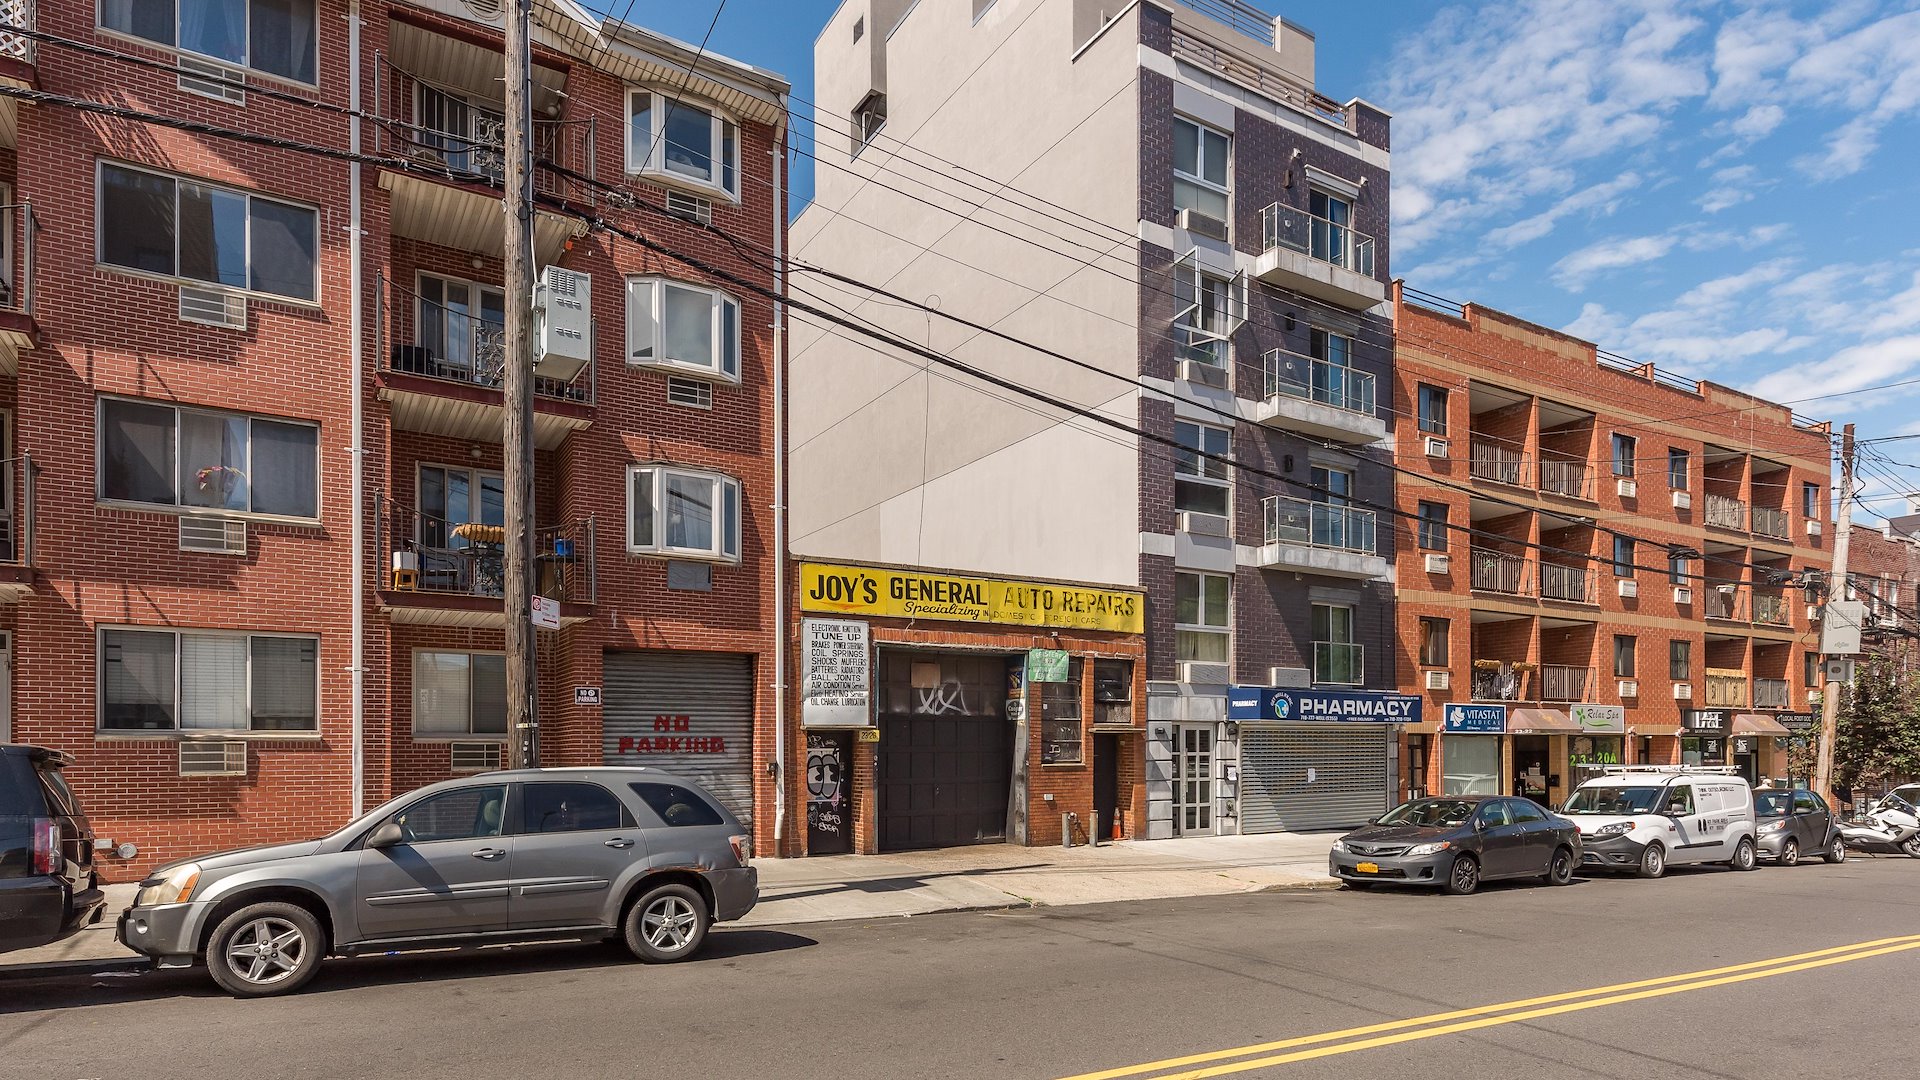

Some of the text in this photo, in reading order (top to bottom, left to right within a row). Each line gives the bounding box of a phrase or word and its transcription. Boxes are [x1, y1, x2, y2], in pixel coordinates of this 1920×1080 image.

[809, 574, 1135, 617] JOY'S GENERAL AUTO REPAIRS
[904, 601, 980, 620] Specializing
[994, 611, 1036, 621] DOMESTC
[1081, 616, 1101, 625] CARS
[811, 624, 840, 632] ELECTRONIC
[811, 632, 861, 641] TUNE UP
[811, 641, 830, 649] BRAKES
[833, 642, 846, 650] POWER
[811, 649, 864, 658] COIL SPRINGS
[811, 666, 838, 674] BATTERIES
[811, 698, 820, 706] OIL
[821, 698, 840, 706] CHANGE
[1232, 700, 1258, 708] PHARMACY
[1300, 698, 1412, 716] PHARMACY
[1467, 710, 1500, 720] VITASTAT
[1587, 708, 1619, 720] Relax Spa
[653, 714, 690, 732] NO
